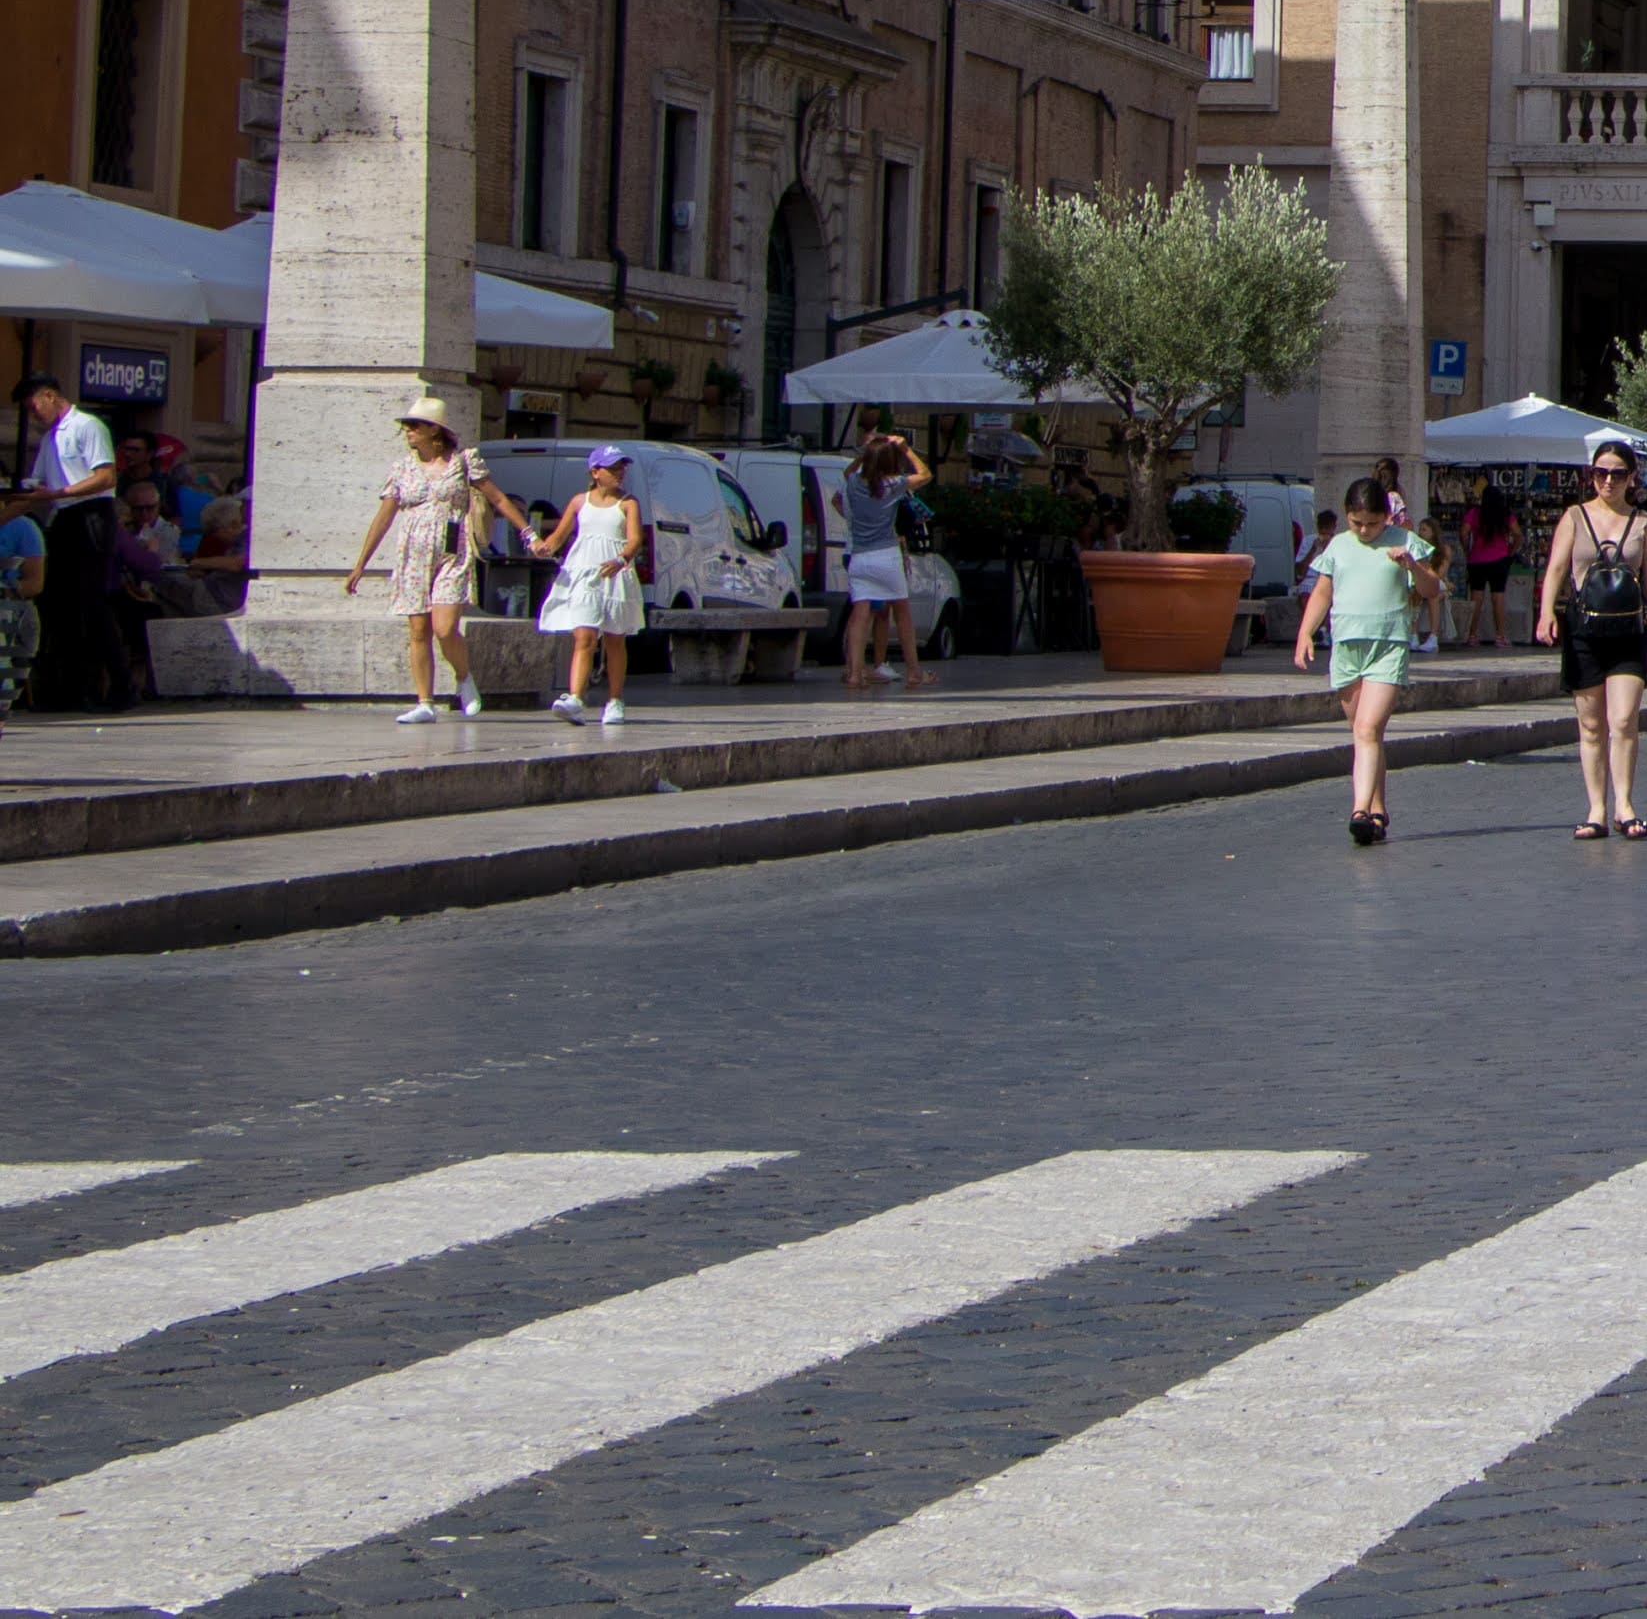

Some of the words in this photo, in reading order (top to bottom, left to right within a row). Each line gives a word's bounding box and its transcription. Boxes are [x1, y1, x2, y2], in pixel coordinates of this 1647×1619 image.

[1560, 185, 1604, 202] PIVS
[1611, 185, 1640, 202] XII
[1439, 344, 1459, 372] P
[85, 354, 145, 394] change
[1492, 469, 1524, 487] ICE
